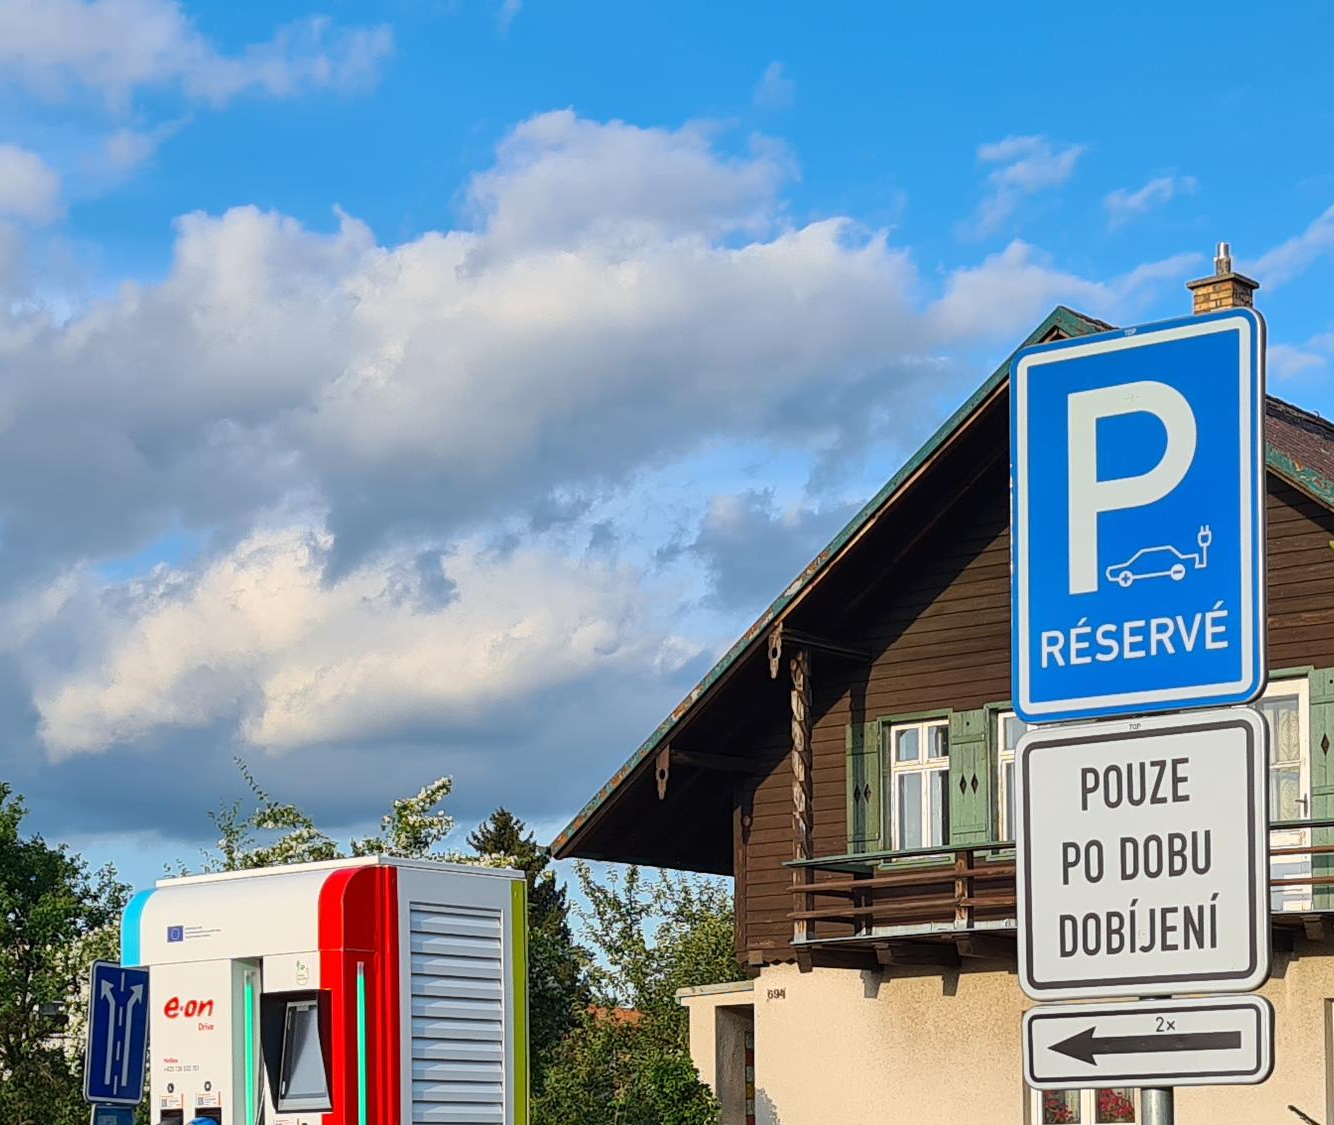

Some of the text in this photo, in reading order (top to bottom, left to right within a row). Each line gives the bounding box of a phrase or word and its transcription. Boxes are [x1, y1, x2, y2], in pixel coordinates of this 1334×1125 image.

[1068, 380, 1197, 595] P
[1041, 600, 1229, 669] RÉSERVÉ
[1080, 757, 1191, 812] POUZE
[1061, 829, 1212, 886] PO DOBU
[1059, 892, 1220, 958] DOBÍJENÍ
